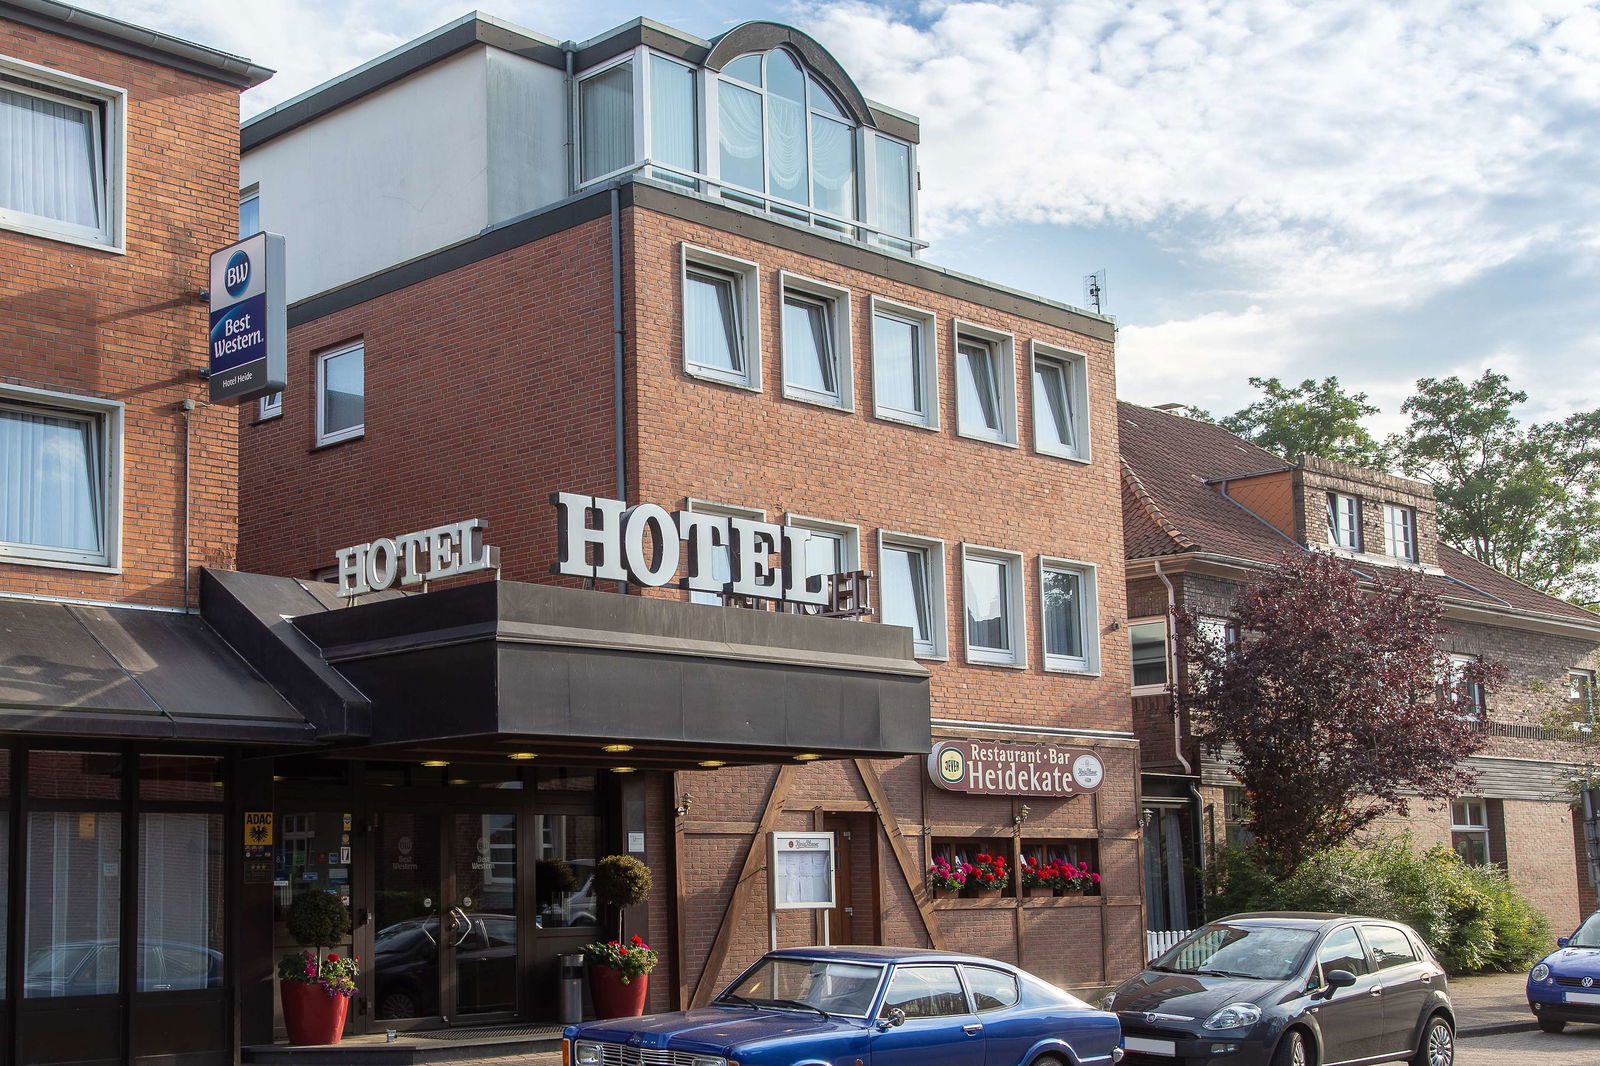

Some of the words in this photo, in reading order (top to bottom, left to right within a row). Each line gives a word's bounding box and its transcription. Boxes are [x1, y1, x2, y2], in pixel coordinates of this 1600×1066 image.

[227, 261, 249, 288] BW
[225, 313, 251, 337] Best
[222, 375, 237, 388] Hotel
[237, 371, 253, 384] Heide
[335, 518, 496, 599] HOTEL
[555, 491, 830, 606] HOTEL
[970, 743, 1042, 764] Restaurant
[1049, 748, 1071, 765] Bar
[944, 760, 960, 773] JEVER
[967, 760, 1073, 793] Heidekate
[246, 814, 272, 826] ADAC
